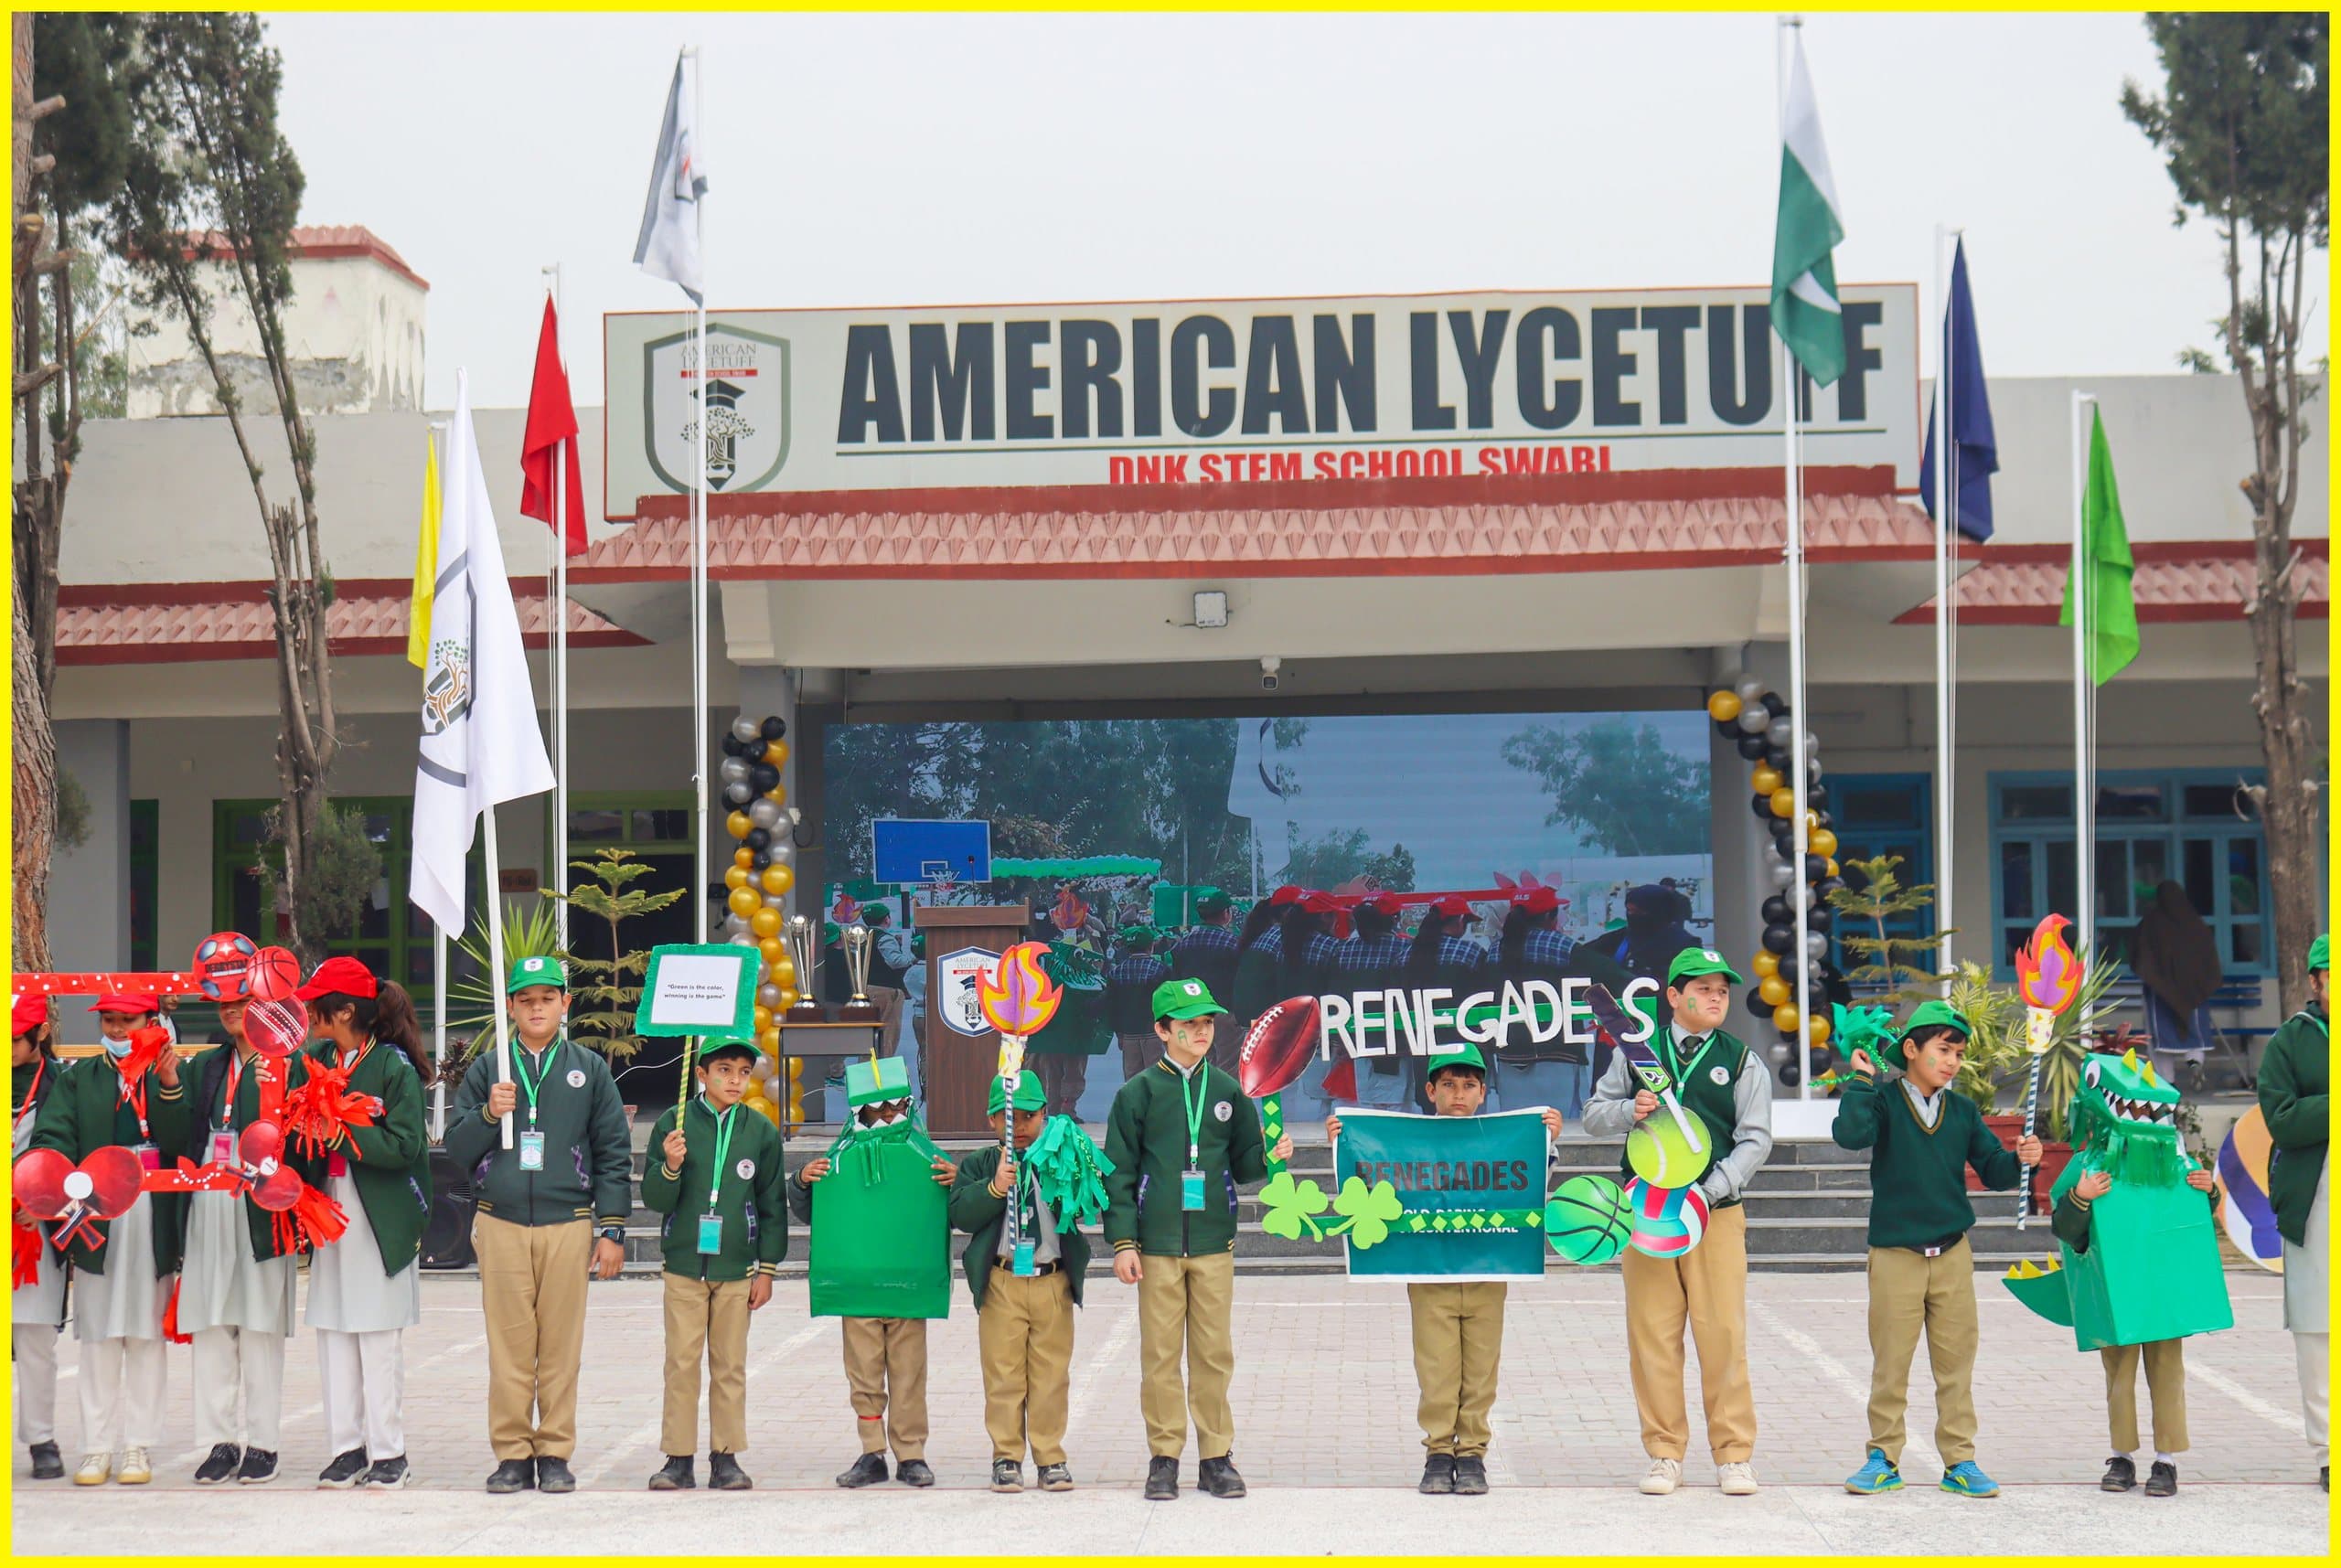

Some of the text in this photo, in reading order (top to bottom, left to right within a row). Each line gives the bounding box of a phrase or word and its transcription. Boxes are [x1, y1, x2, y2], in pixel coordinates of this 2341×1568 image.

[682, 356, 755, 368] LYETUFF
[836, 301, 1884, 443] AMERICAN LYCETUF
[1320, 977, 1660, 1061] RENEGADES
[1356, 1159, 1530, 1192] RENEGADES
